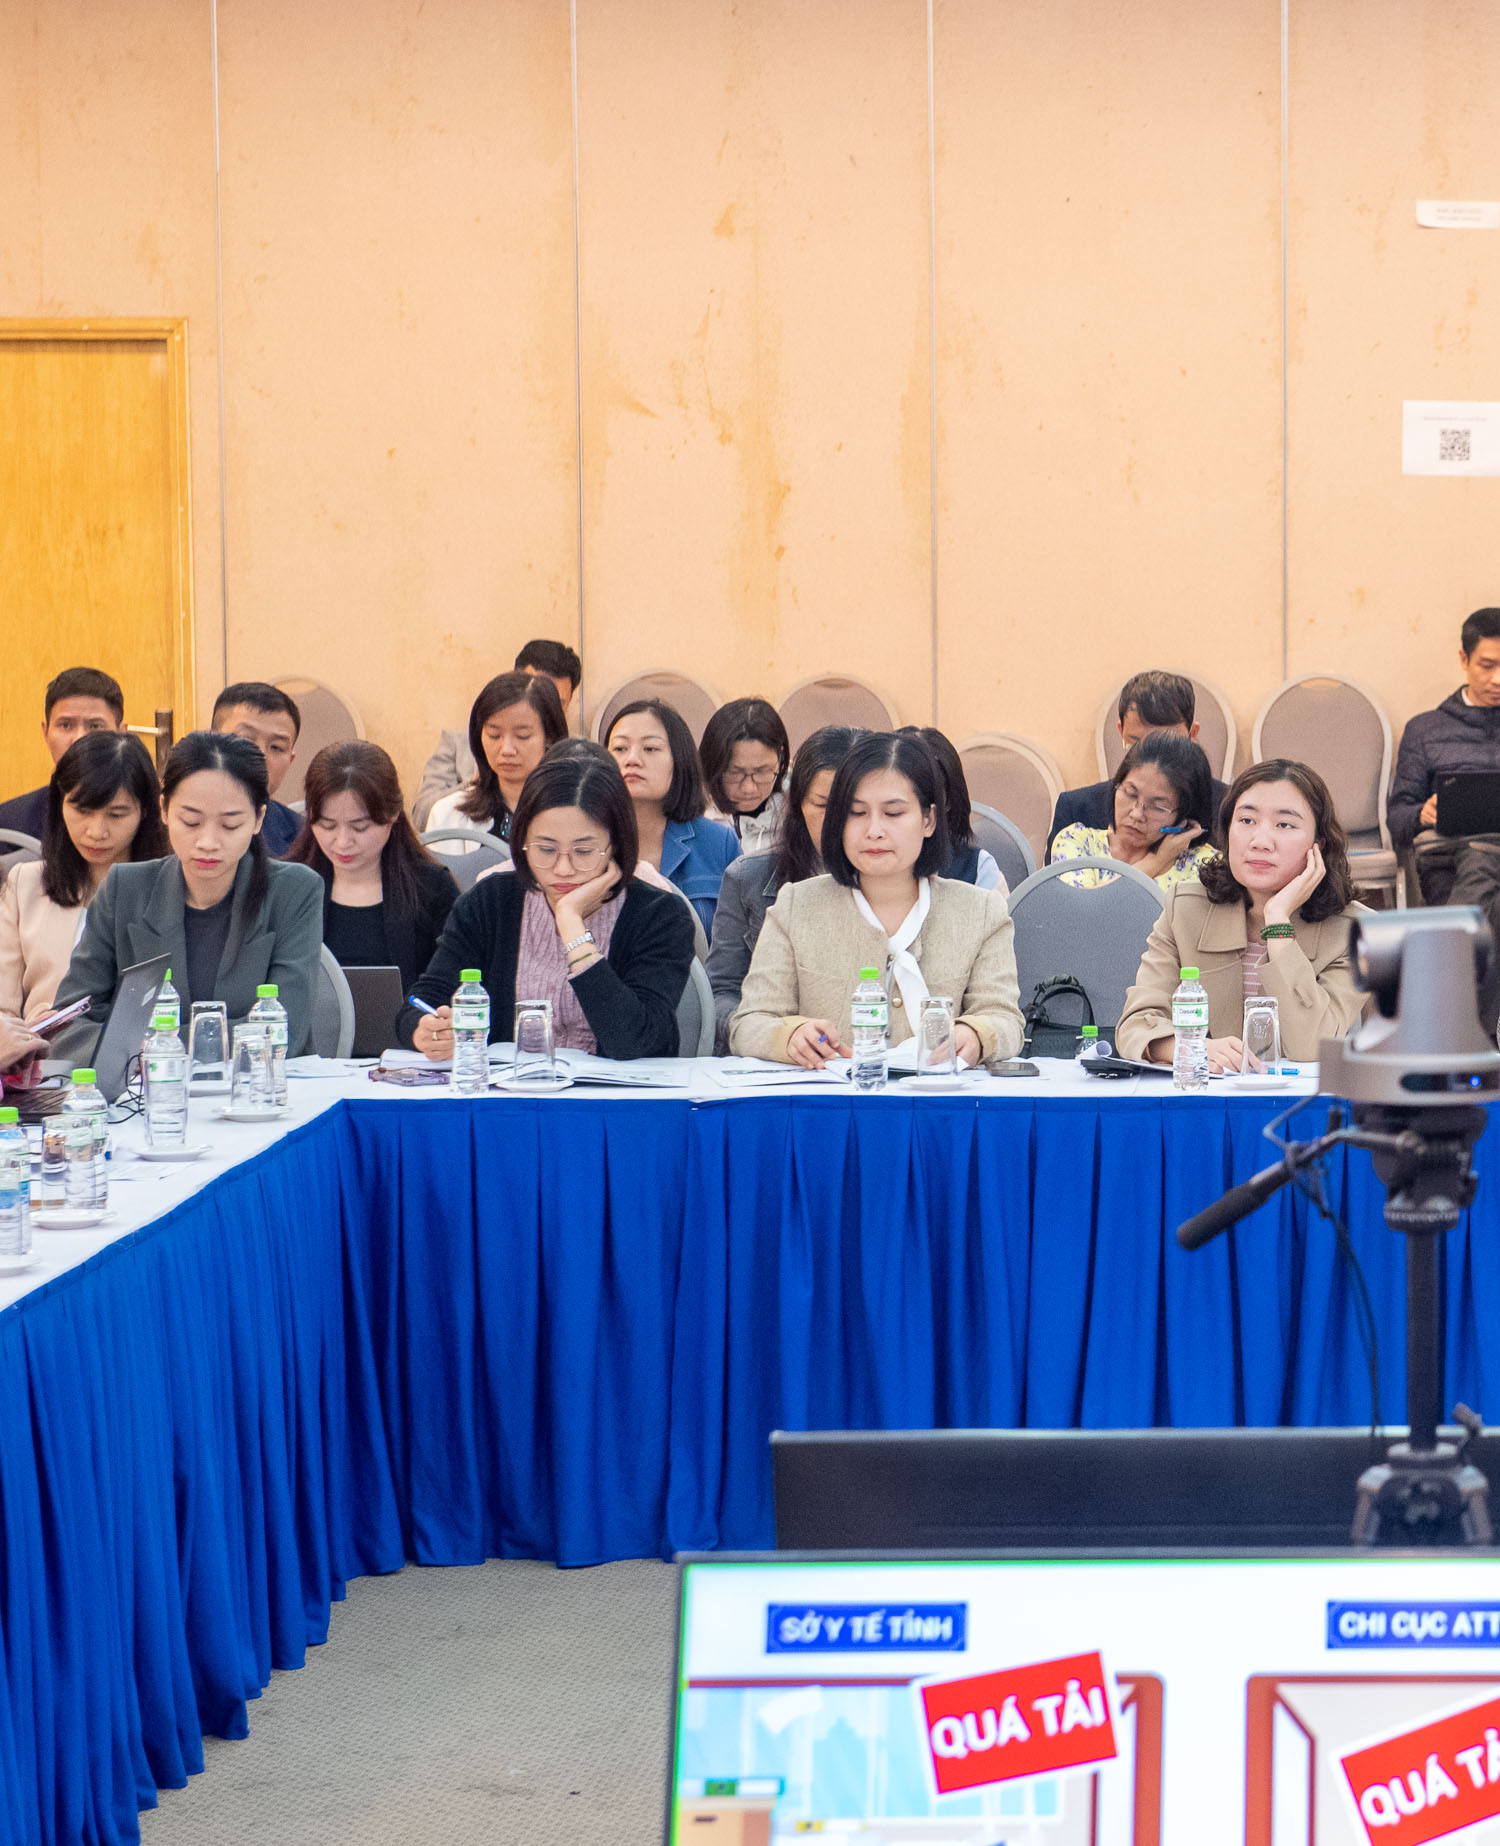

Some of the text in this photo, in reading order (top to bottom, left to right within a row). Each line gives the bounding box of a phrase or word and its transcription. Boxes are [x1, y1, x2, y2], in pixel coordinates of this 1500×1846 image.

[823, 1616, 845, 1642] Y
[848, 1608, 886, 1643] TẾ
[887, 1608, 953, 1642] TỈNH
[1339, 1610, 1387, 1639] CHI
[1391, 1610, 1448, 1643] CỤC
[931, 1678, 1106, 1760] QUÁ TẢI
[1360, 1752, 1459, 1827] QUÁ
